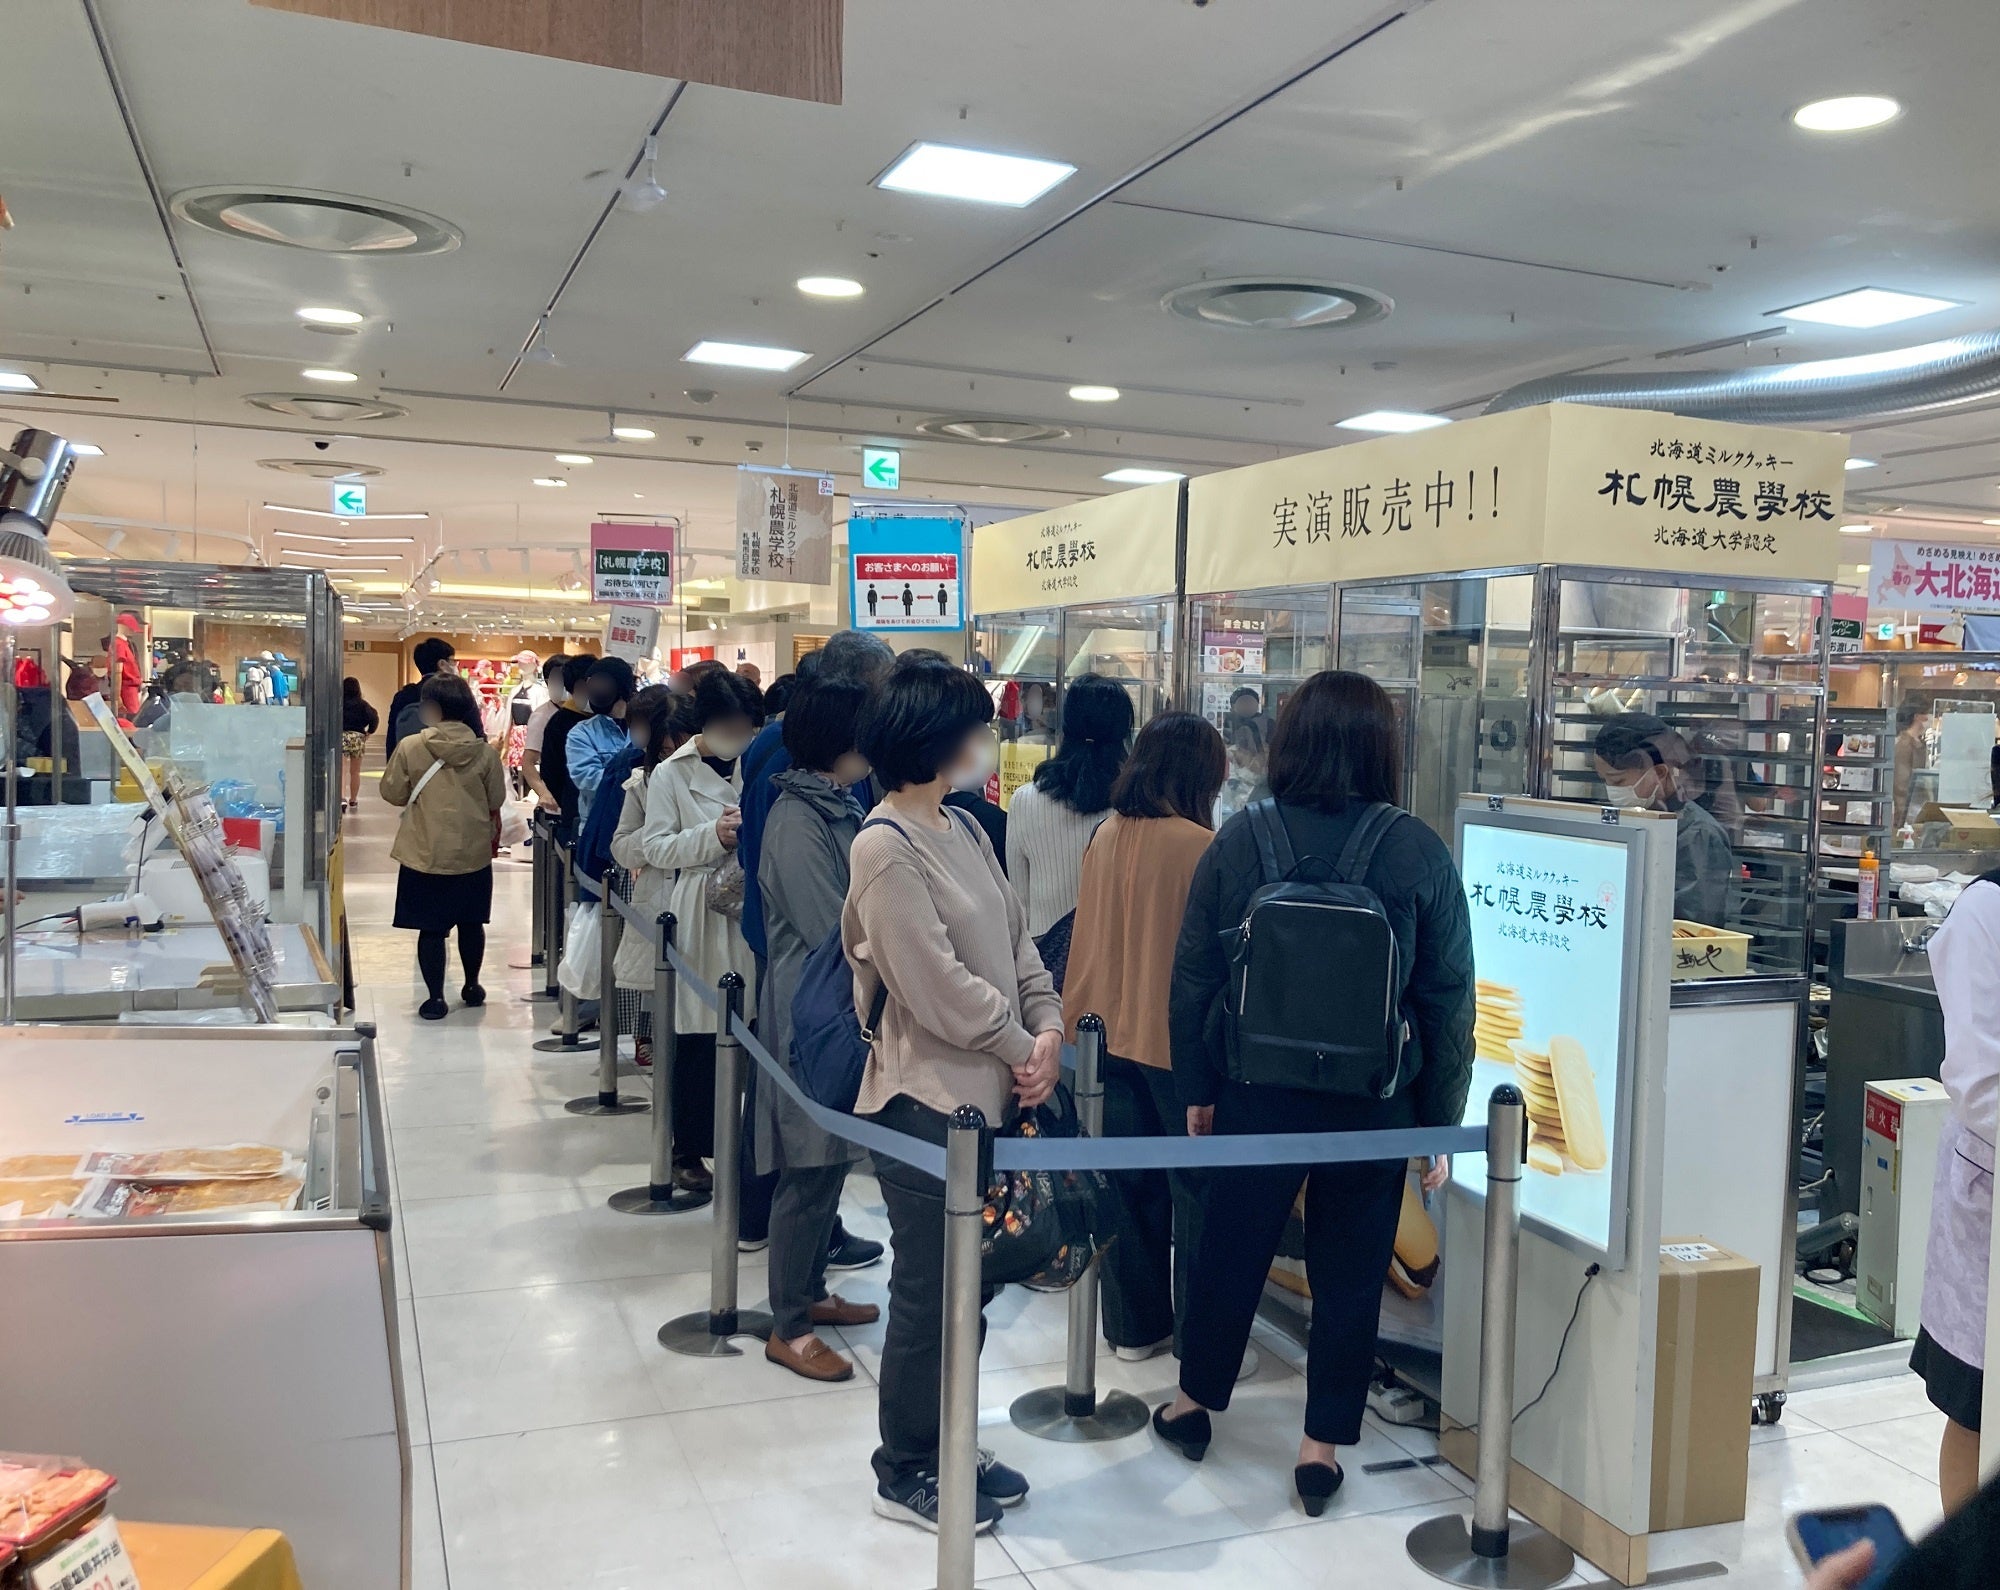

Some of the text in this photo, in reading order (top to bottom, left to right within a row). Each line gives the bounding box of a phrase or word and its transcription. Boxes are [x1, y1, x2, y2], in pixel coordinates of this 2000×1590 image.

[1650, 438, 1794, 471] 北海道ミルククッキー
[1597, 468, 1836, 522] 札幌農學校
[768, 486, 786, 569] 札幌農学校
[786, 482, 798, 575] 北海道ミルククッキー
[1653, 527, 1778, 555] 北海道大学認定
[751, 531, 761, 575] 札幌農学校
[864, 562, 949, 573] お客さまへのお願い
[1026, 539, 1097, 572] 札幌農學校
[1496, 861, 1580, 887] 北海道ミルククッキー
[1469, 881, 1608, 930] 札幌農學校
[1497, 922, 1572, 952] 北海道大学認定
[1866, 1105, 1899, 1134] 消火器
